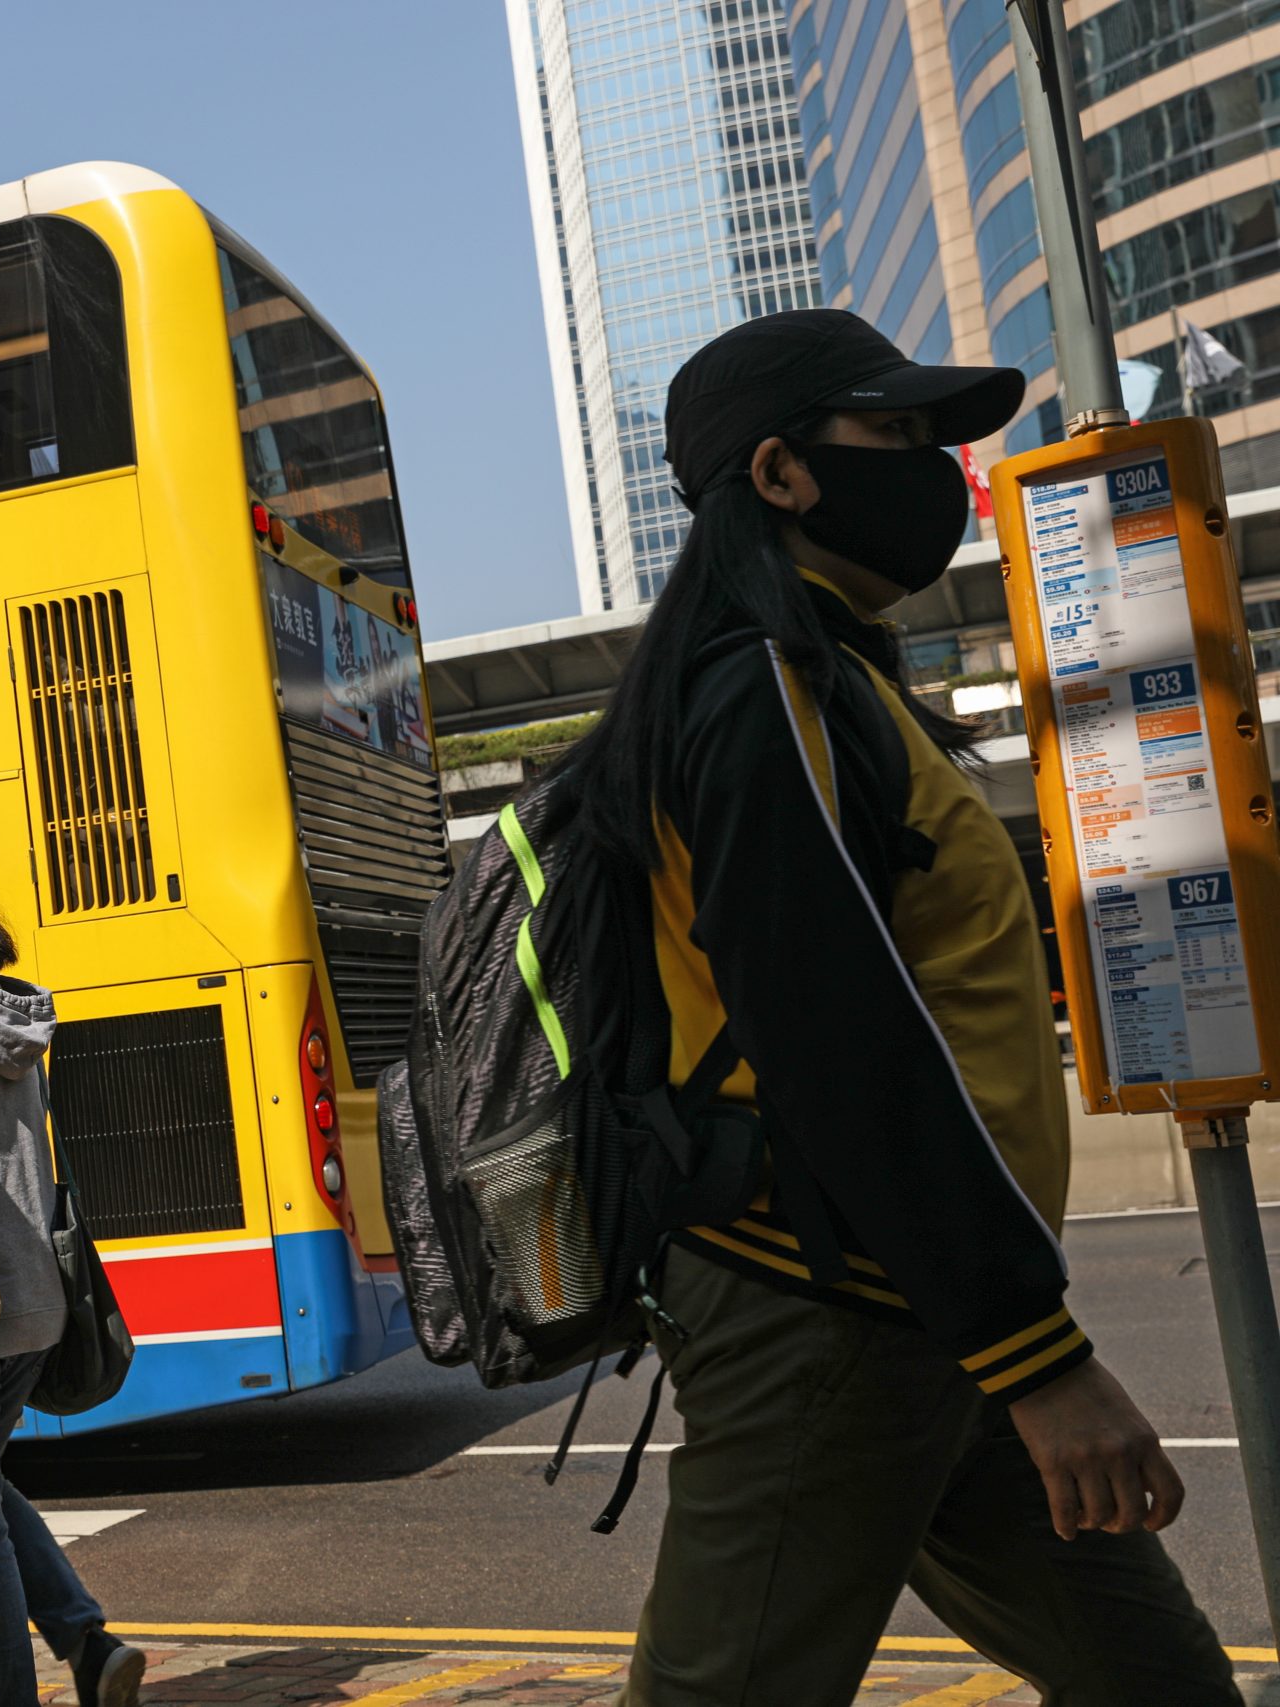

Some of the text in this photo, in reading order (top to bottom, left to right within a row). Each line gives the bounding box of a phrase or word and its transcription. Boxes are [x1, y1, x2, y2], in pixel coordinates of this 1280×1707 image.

[1115, 465, 1162, 497] 930A
[1143, 670, 1183, 699] 933
[1179, 877, 1220, 905] 967
